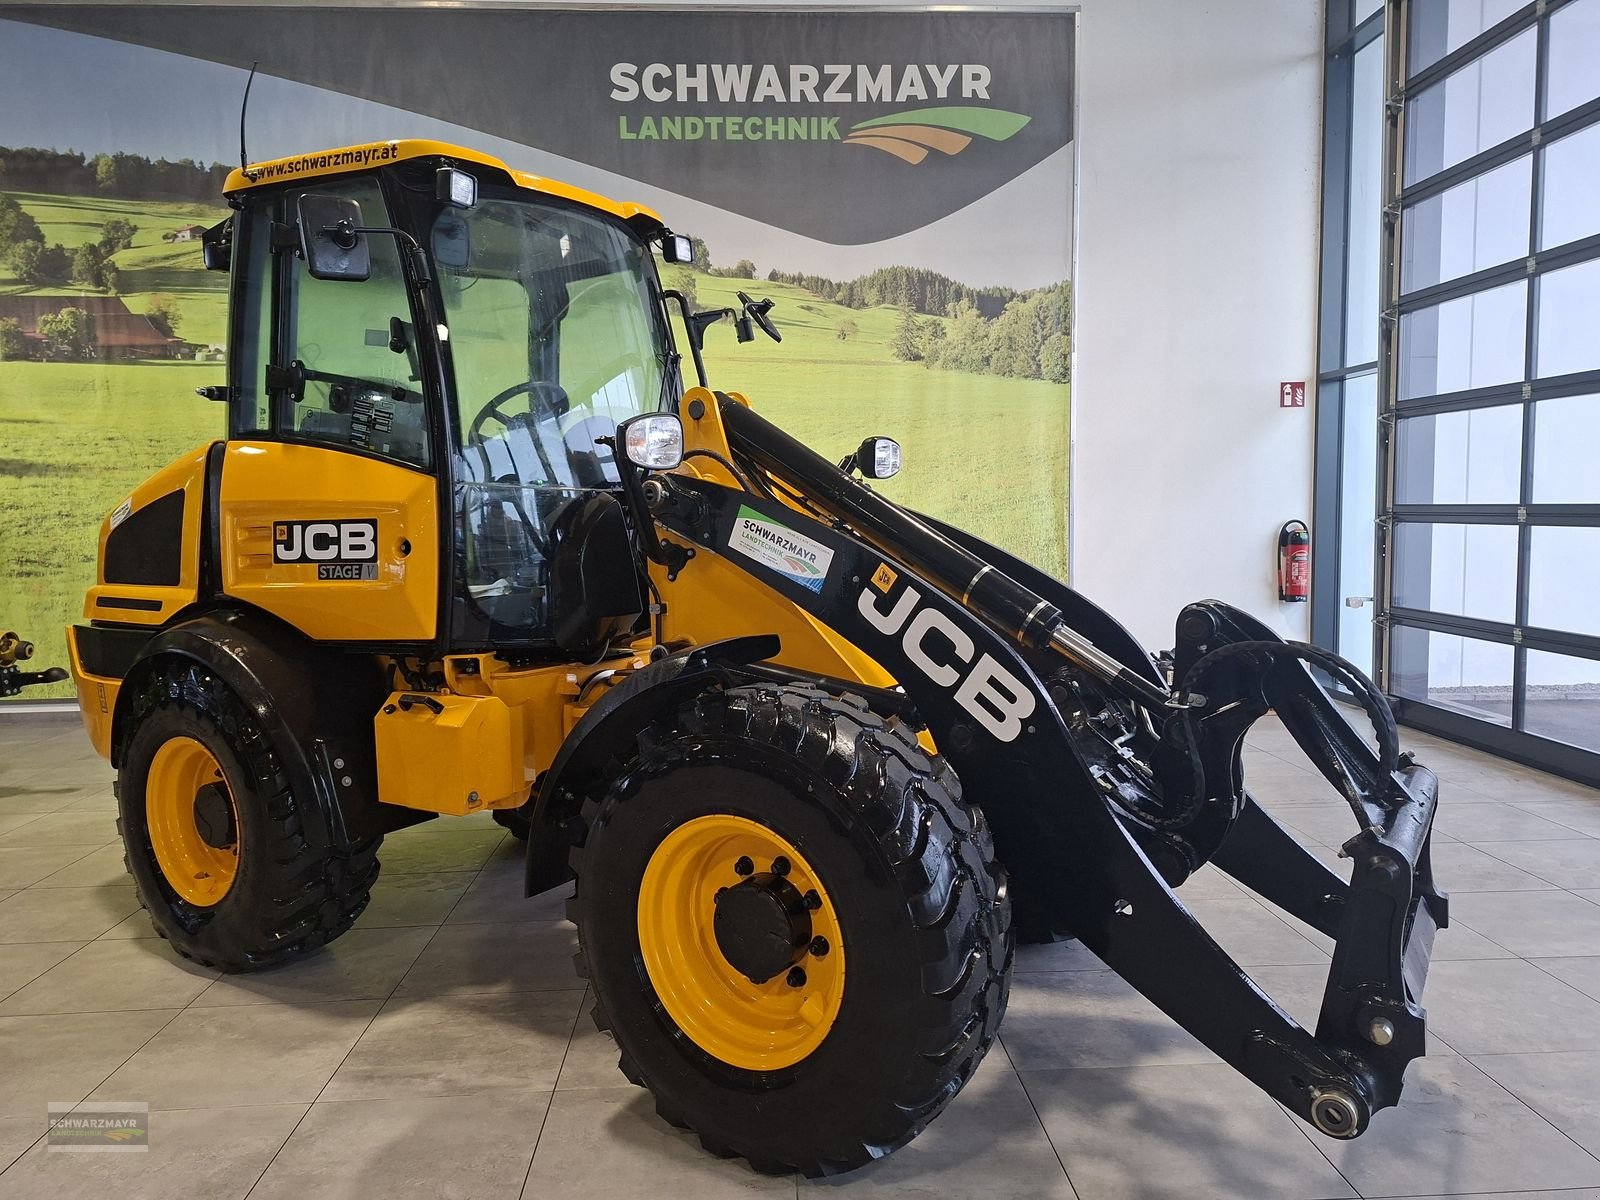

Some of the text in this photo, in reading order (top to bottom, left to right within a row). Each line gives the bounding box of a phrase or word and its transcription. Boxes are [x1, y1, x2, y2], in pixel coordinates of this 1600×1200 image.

[609, 62, 992, 103] SCHWARZMAYR
[619, 115, 841, 141] LANDTECHNIK
[257, 143, 398, 179] www.schwarzmayr.at
[276, 523, 376, 560] JCB
[741, 531, 784, 558] LANDTECHNIK
[743, 519, 817, 564] SCHWARZMAYR
[319, 565, 360, 579] STAGE
[857, 585, 1036, 743] JCB
